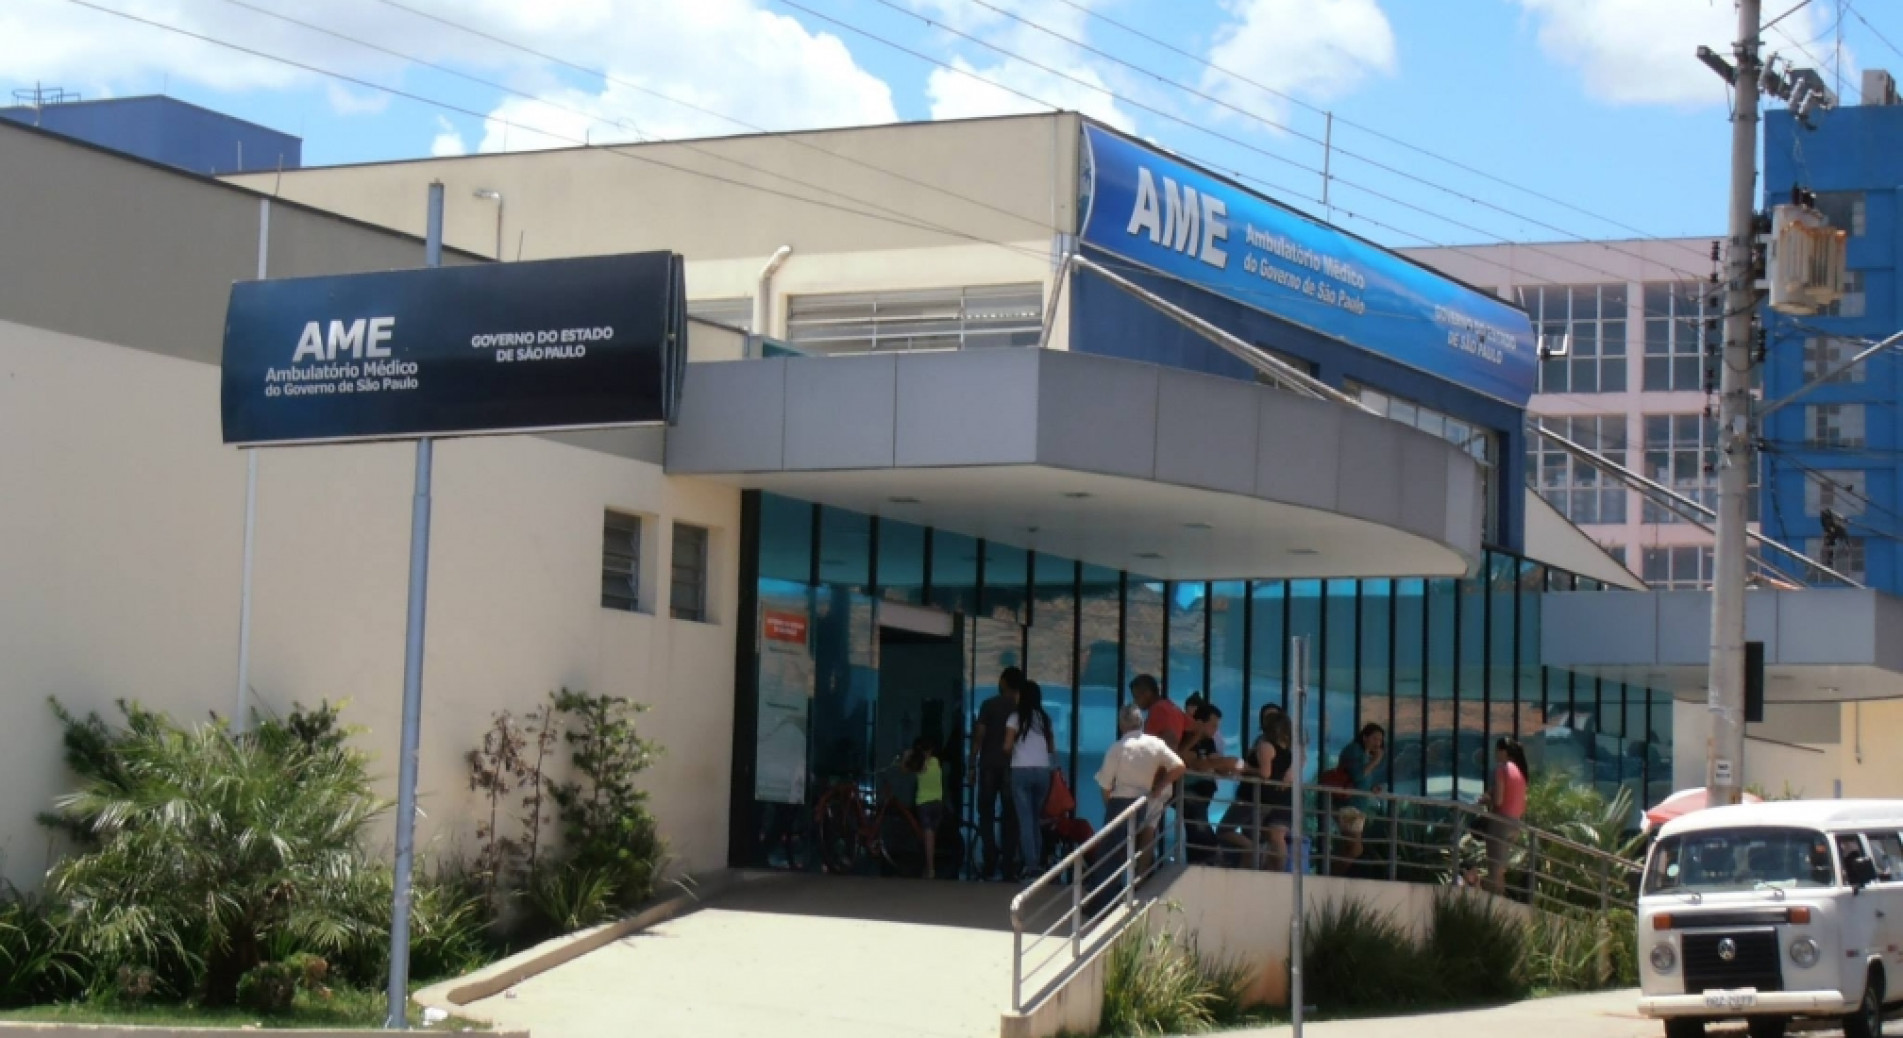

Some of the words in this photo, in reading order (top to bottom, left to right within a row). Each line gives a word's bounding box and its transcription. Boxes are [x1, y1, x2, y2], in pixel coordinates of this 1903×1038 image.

[1126, 166, 1229, 270] AME
[1246, 222, 1320, 271] Ambulatório
[1323, 254, 1365, 289] Médico
[1244, 253, 1257, 273] do
[1260, 257, 1301, 290] Governo
[1302, 276, 1315, 296] de
[1318, 281, 1336, 304] São
[1339, 289, 1365, 315] Paulo
[292, 316, 395, 363] AME
[471, 331, 535, 348] GOVERNO
[537, 329, 557, 345] DO
[561, 325, 614, 343] ESTADO
[496, 347, 514, 363] DE
[517, 345, 542, 361] SÃO
[545, 344, 586, 360] PAULO
[265, 361, 359, 383] Ambulatório
[363, 359, 418, 377] Médico
[265, 384, 281, 397] do
[284, 381, 336, 396] Governo
[338, 380, 354, 393] de
[356, 377, 380, 392] São
[383, 375, 418, 391] Paulo
